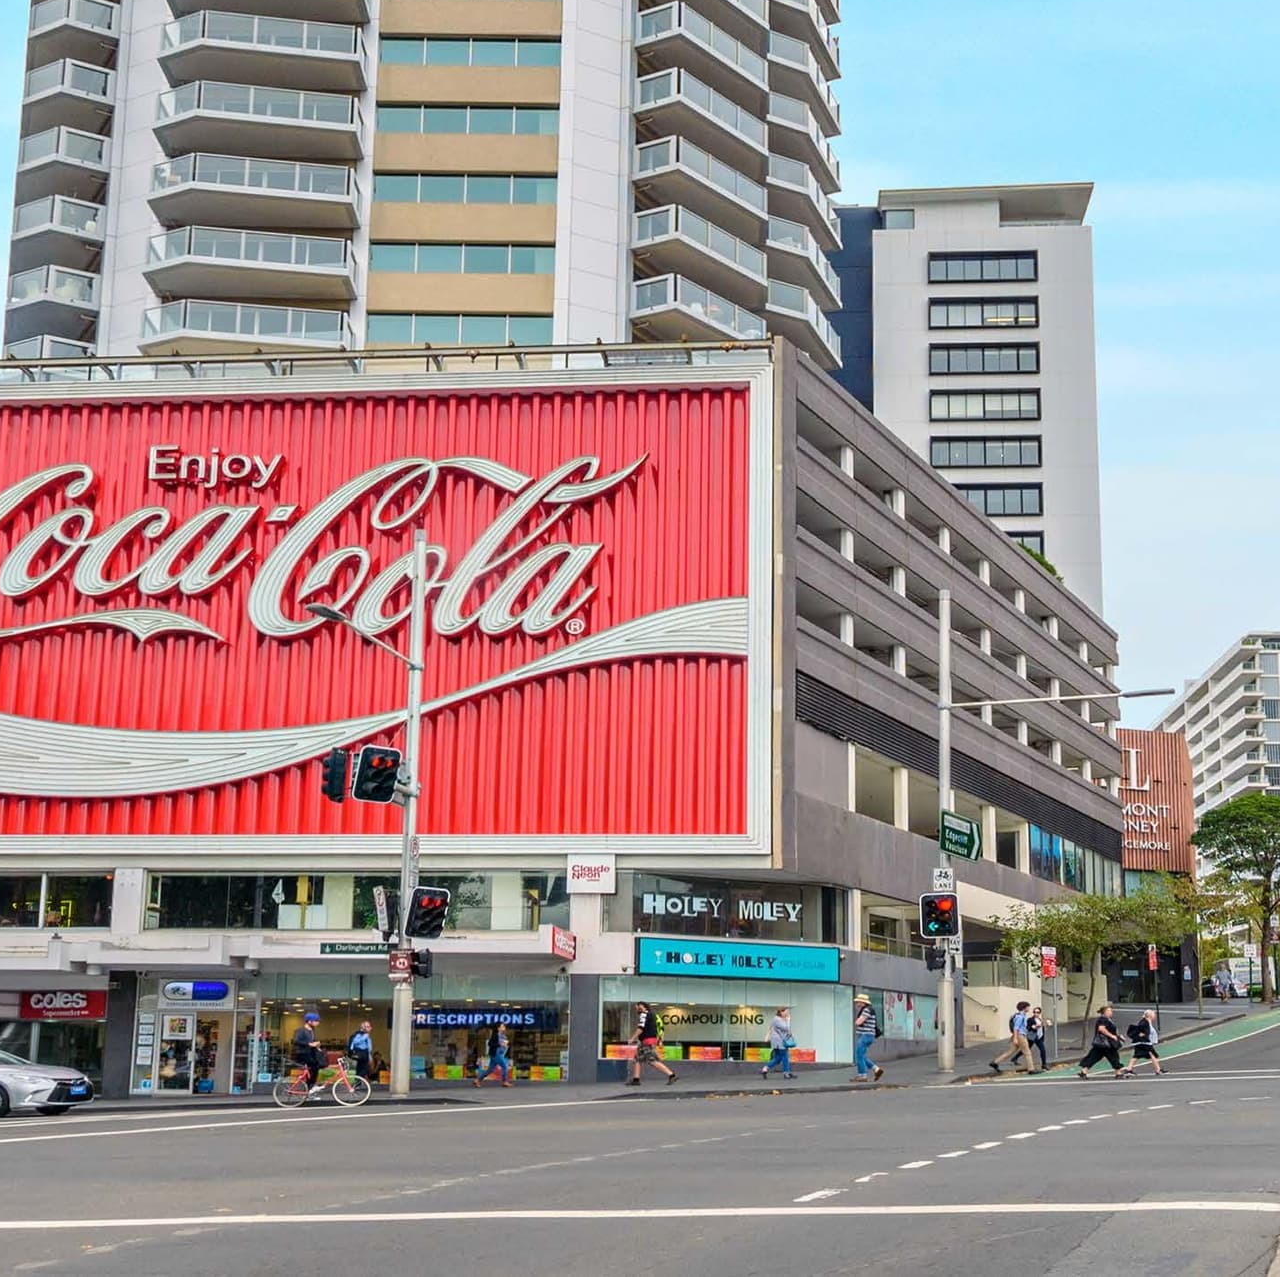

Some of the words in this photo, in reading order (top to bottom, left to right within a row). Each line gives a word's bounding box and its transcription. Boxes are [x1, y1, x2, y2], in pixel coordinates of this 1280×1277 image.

[147, 443, 285, 491] Enjoy
[571, 864, 610, 873] Claude
[571, 872, 600, 880] Neon
[643, 893, 723, 918] HOLEY
[738, 900, 802, 922] MOLEY
[335, 944, 377, 952] Darlinghurst
[378, 943, 388, 951] Rd
[666, 951, 725, 967] HOLEY
[30, 992, 87, 1008] coles
